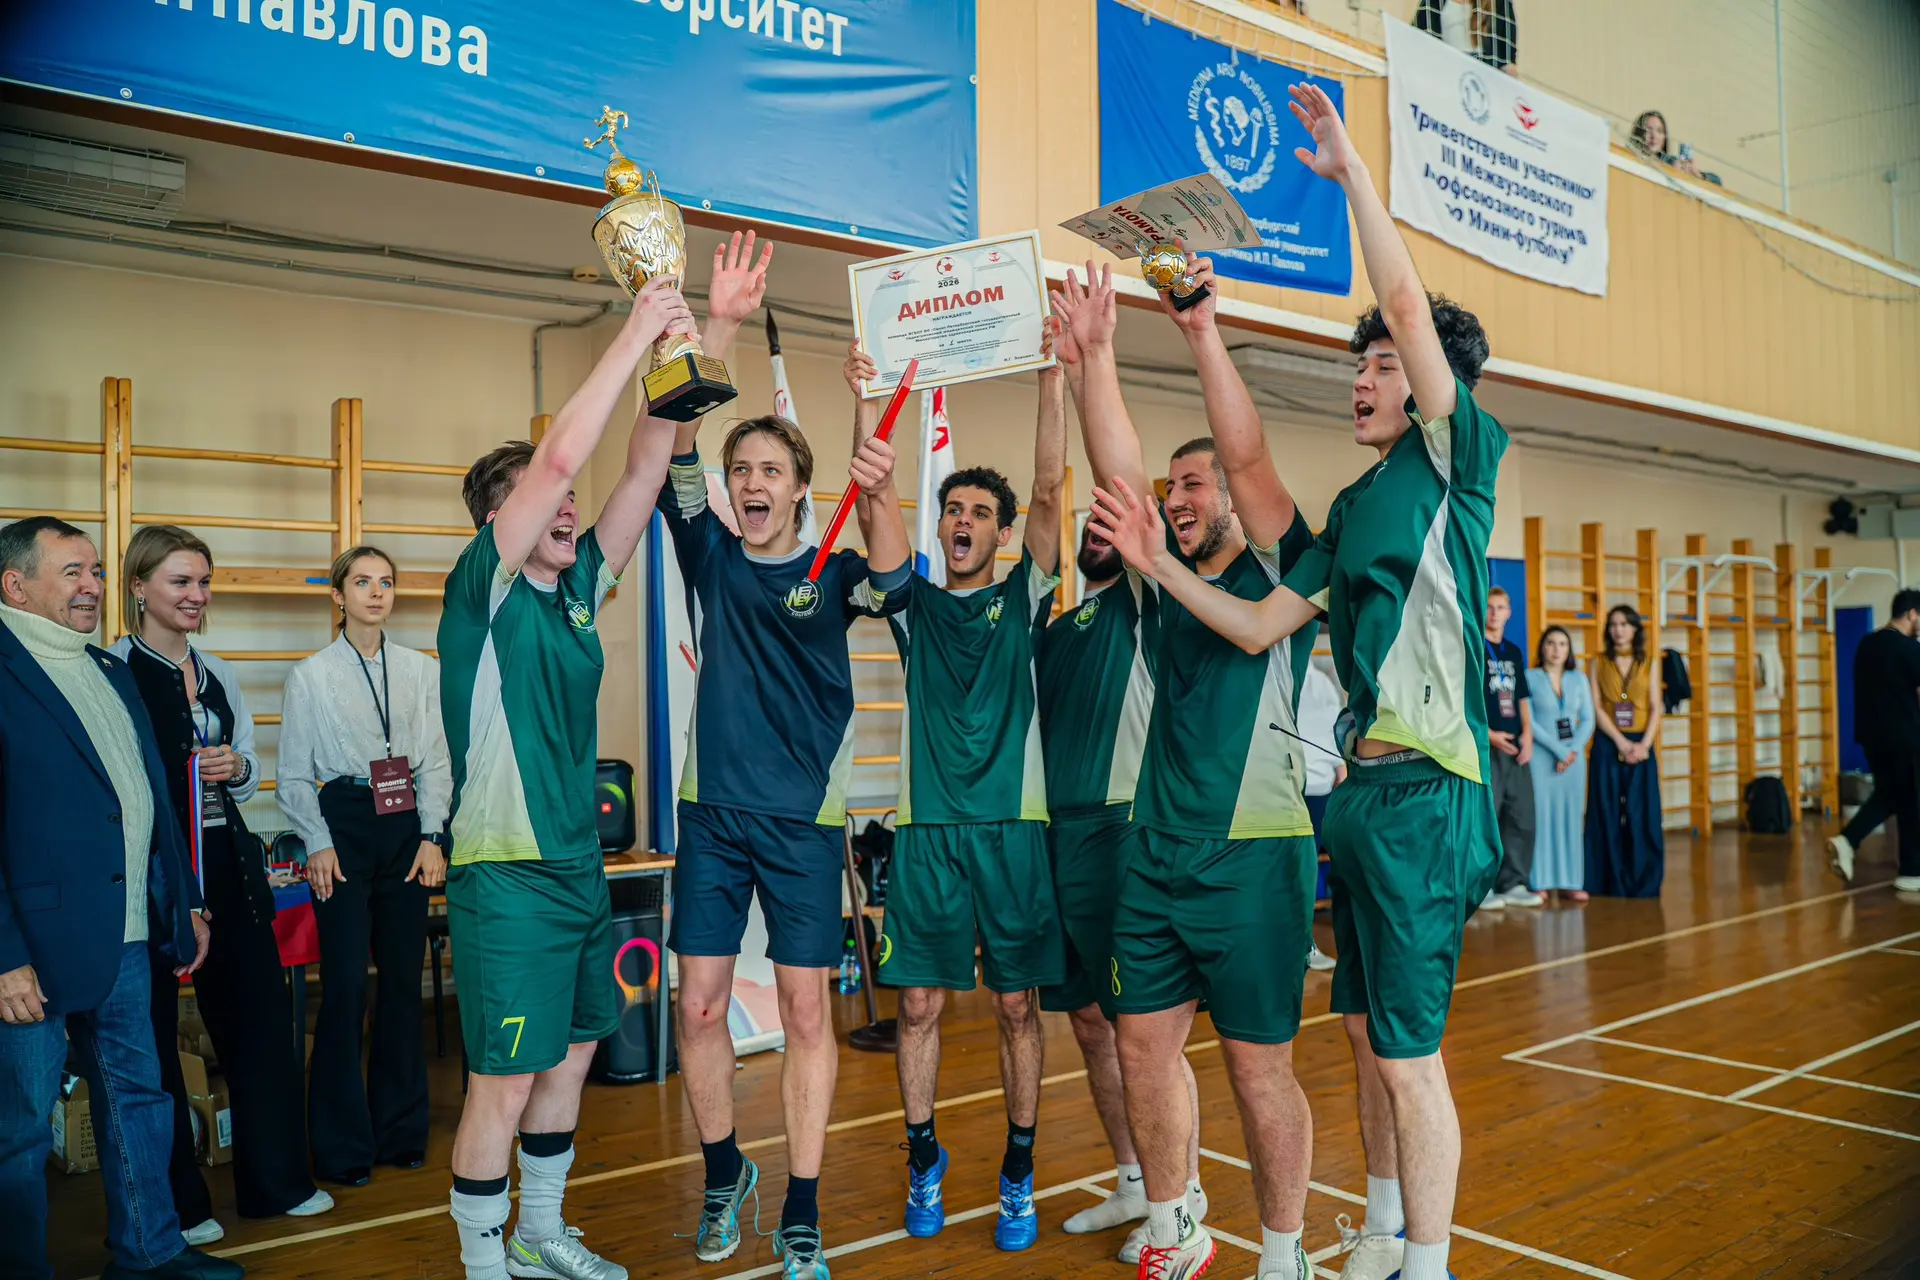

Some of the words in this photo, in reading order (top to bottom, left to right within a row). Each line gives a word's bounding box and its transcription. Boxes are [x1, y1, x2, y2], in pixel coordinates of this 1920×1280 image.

[632, 0, 848, 56] рситет
[1216, 62, 1236, 78] ARS
[1224, 153, 1251, 172] 1897
[938, 279, 960, 289] 2026
[897, 285, 1005, 322] ДИПЛОМ
[932, 311, 972, 322] НАГРАЖДАЕТСЯ
[1110, 957, 1122, 996] 8
[500, 1016, 526, 1058] 7
